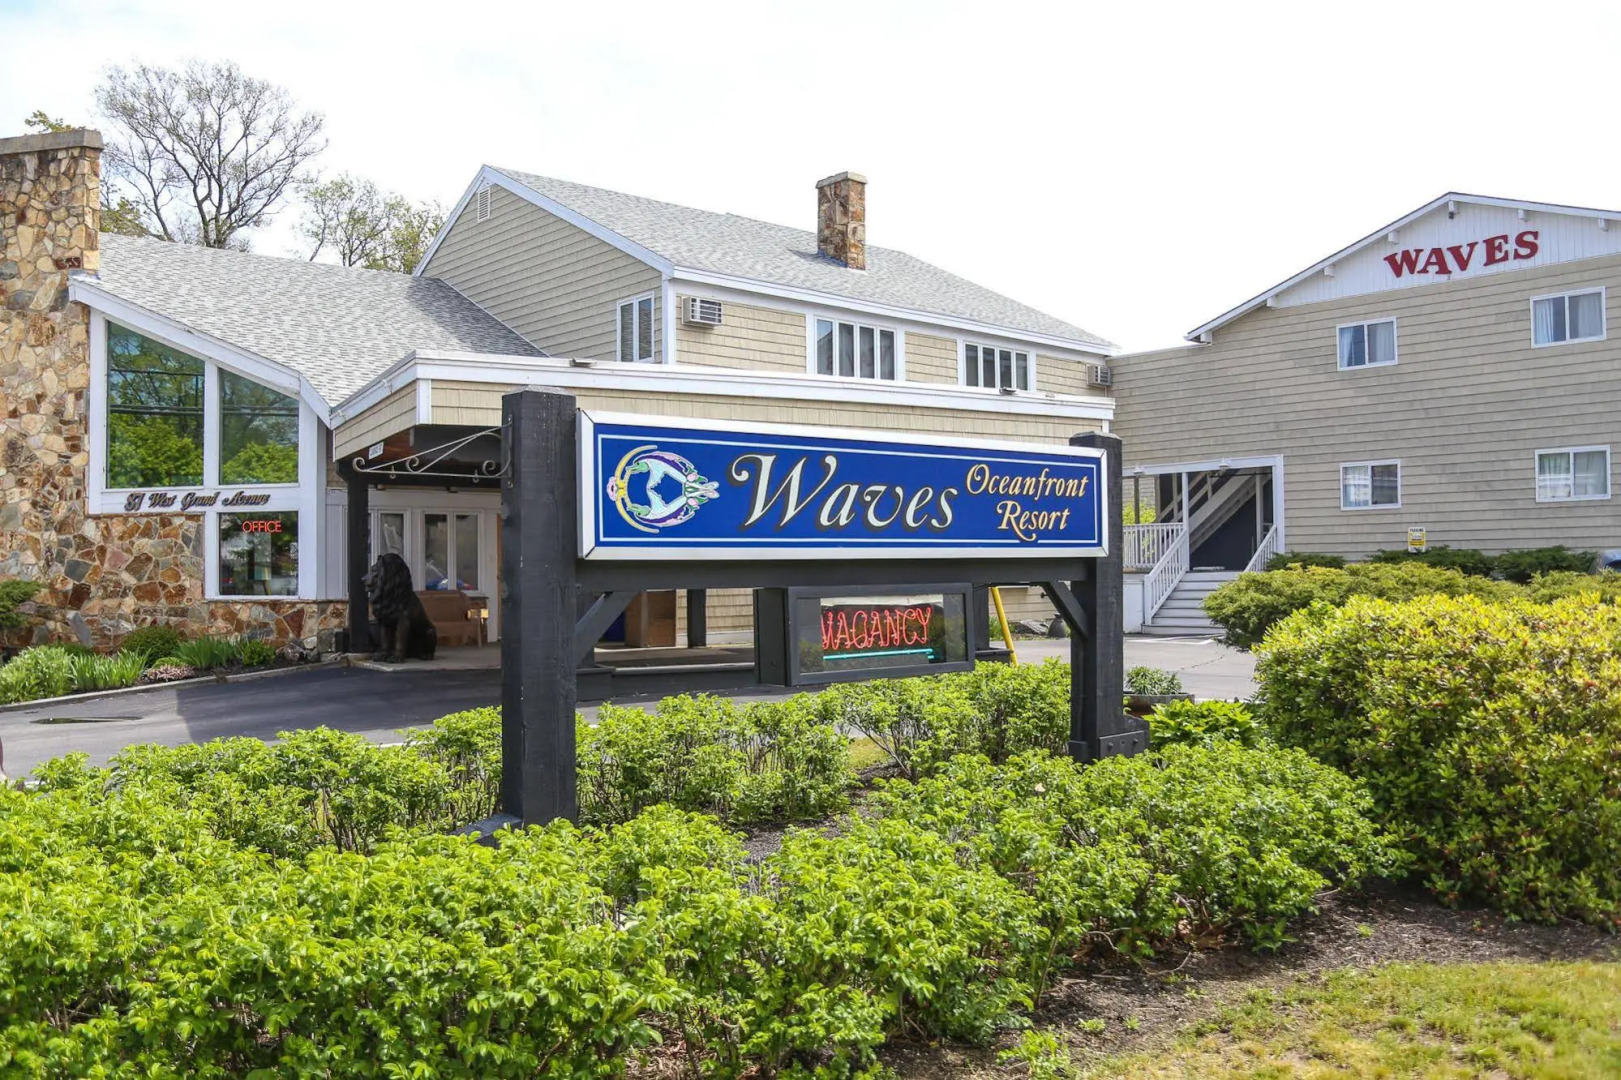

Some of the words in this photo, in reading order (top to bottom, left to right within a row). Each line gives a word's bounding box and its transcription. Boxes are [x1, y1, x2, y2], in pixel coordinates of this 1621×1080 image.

[1383, 230, 1540, 278] WAVES
[148, 493, 177, 508] West
[180, 492, 220, 511] Grand
[222, 491, 271, 506] Avenue
[731, 453, 958, 528] Waves
[965, 463, 1090, 499] Oceanfront
[242, 520, 282, 533] OFFICE
[996, 500, 1071, 541] Resort
[820, 607, 932, 650] VACANCY
